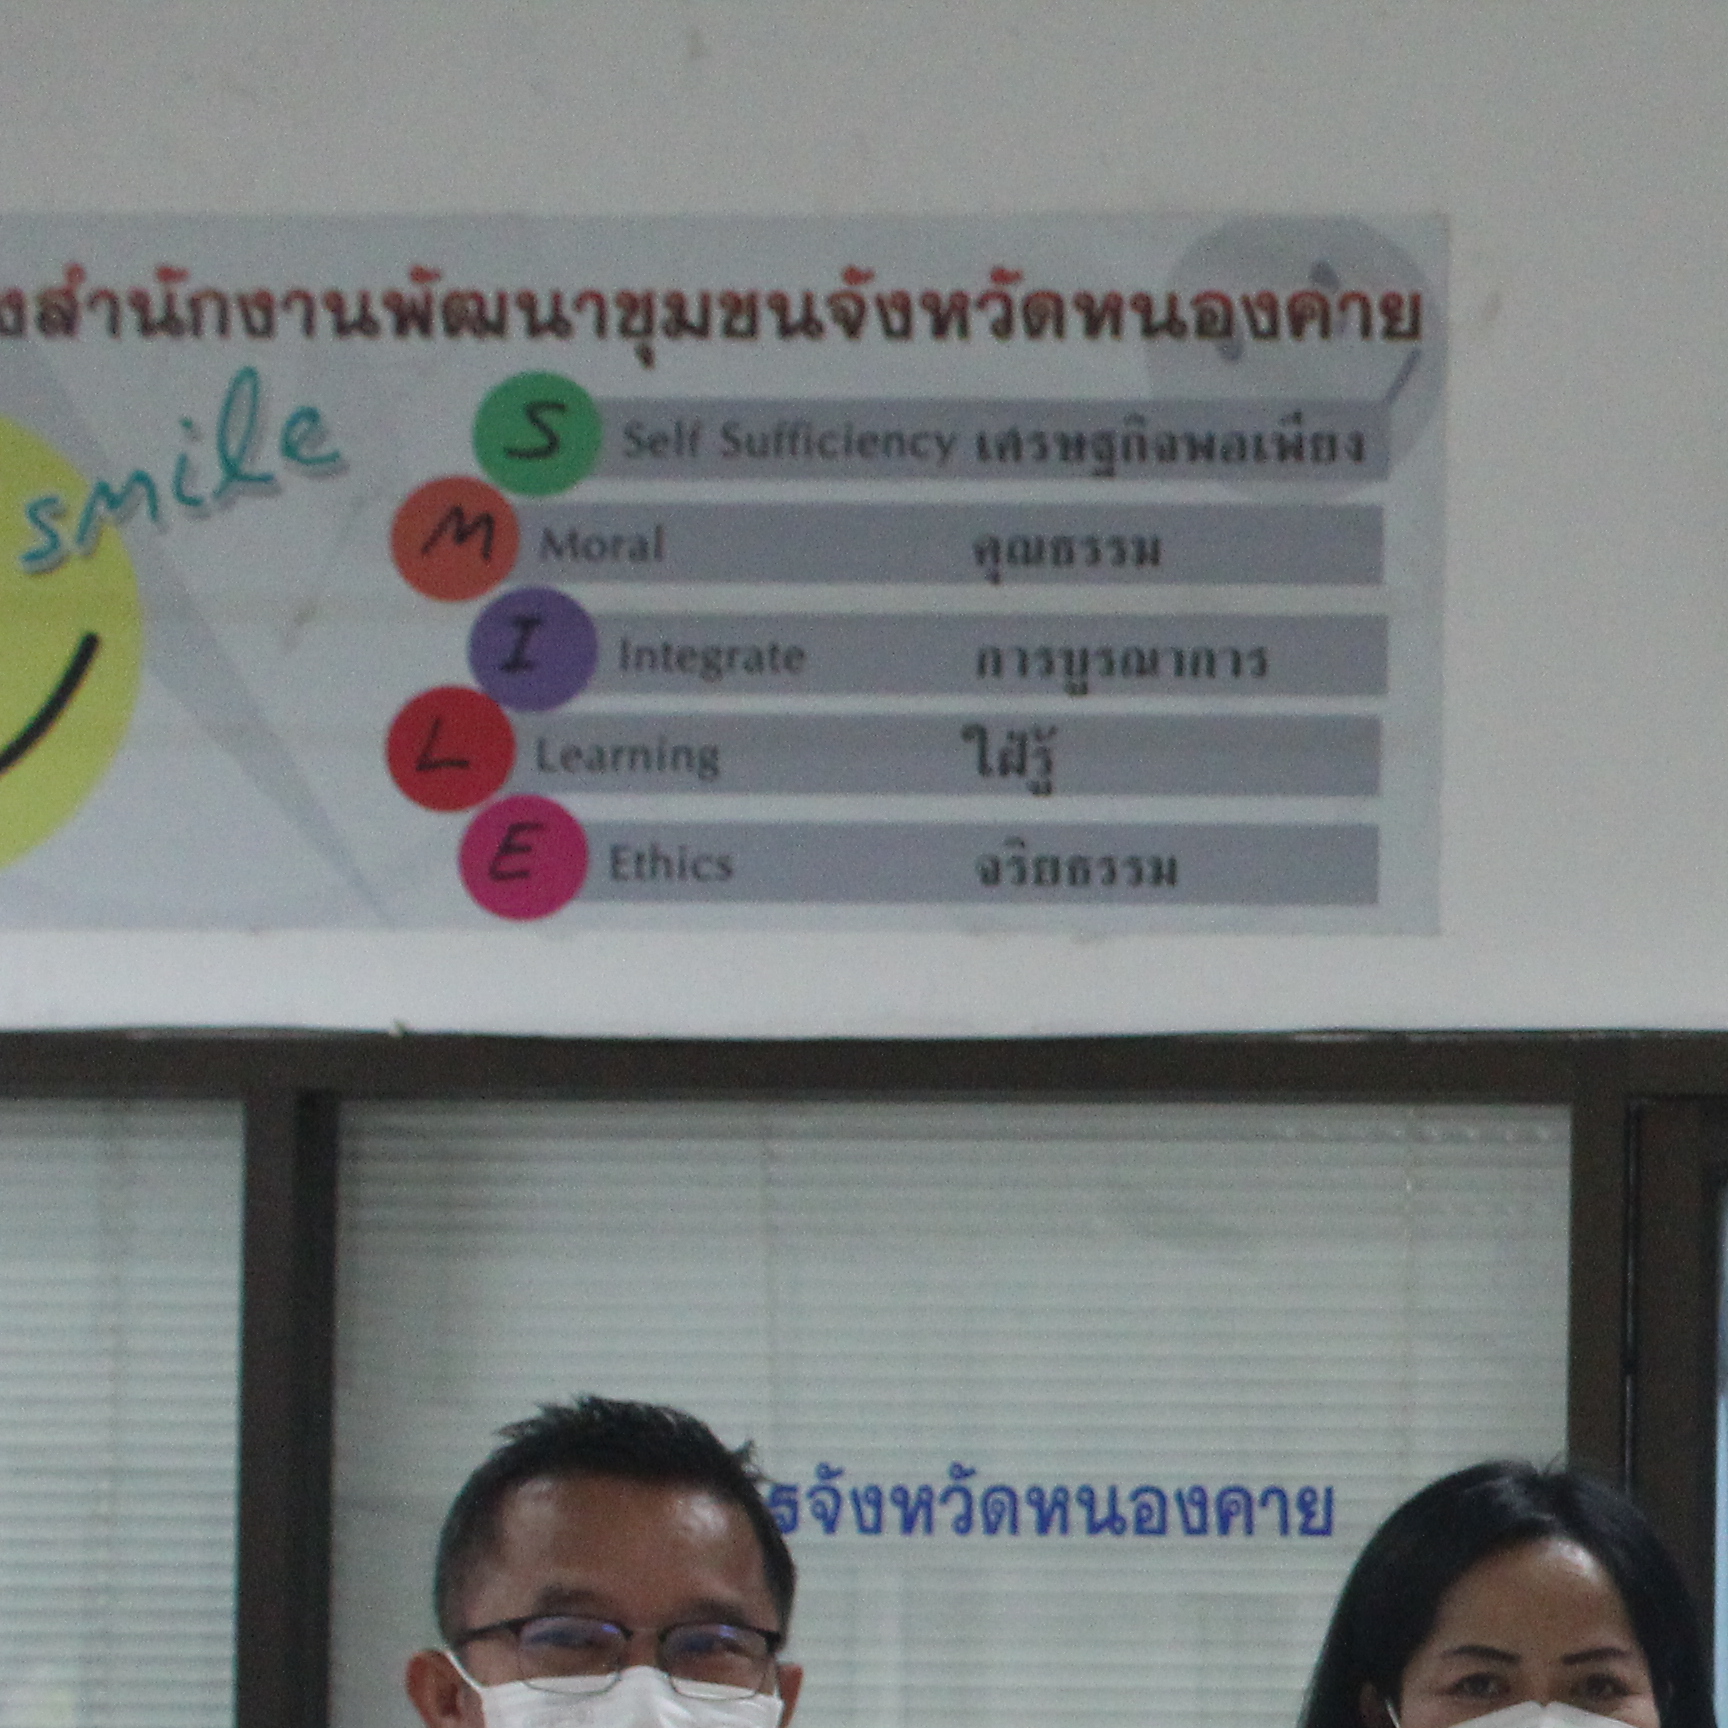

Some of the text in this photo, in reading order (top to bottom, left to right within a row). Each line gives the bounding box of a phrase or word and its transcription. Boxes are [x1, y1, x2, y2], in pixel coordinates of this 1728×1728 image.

[21, 365, 342, 568] smile
[503, 402, 567, 459] S
[623, 421, 700, 461] Self
[719, 419, 958, 464] Sufficiency
[420, 504, 1163, 585] M Moral คุณธรรม
[500, 614, 1268, 696] I Integrate การบูรณาการ
[415, 717, 469, 772] L
[536, 738, 721, 779] Learning
[488, 821, 1178, 887] E Ethics จริยธรรม
